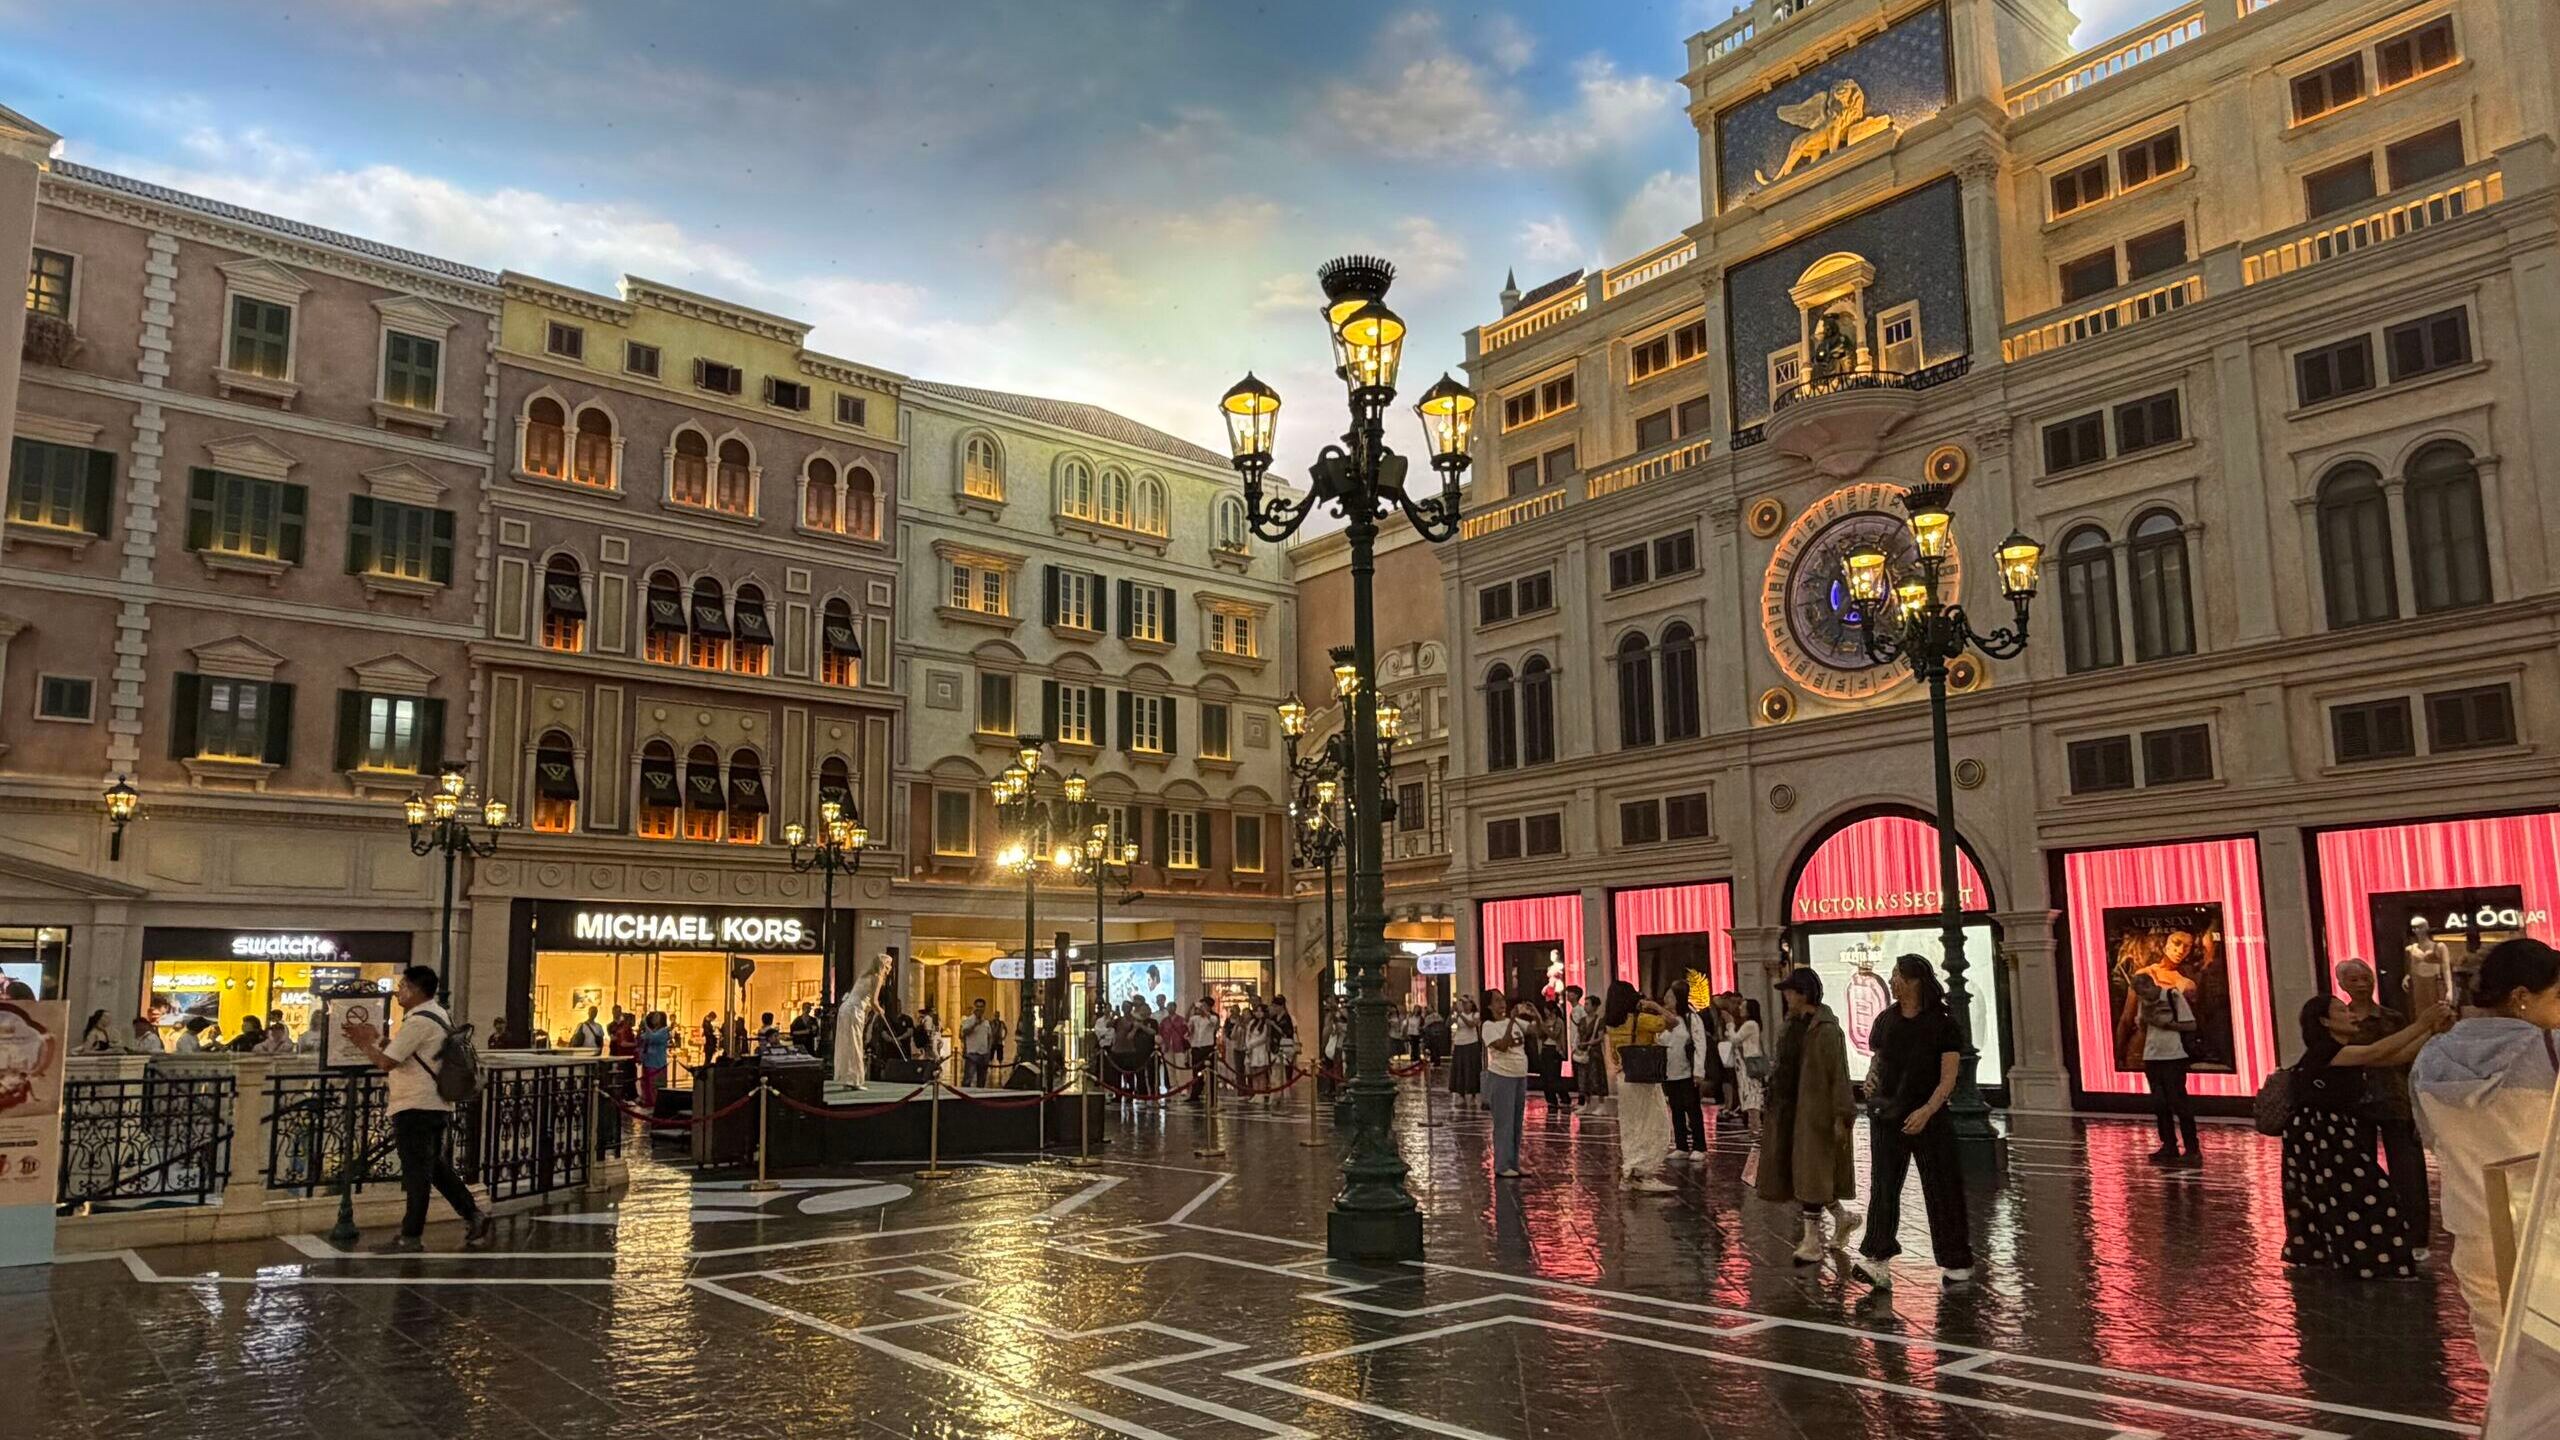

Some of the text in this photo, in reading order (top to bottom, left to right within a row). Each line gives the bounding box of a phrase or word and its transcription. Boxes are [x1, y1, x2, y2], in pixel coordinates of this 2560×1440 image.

[1799, 887, 1974, 914] VICTORIA'S SECT
[575, 913, 802, 943] MICHAEL KORS
